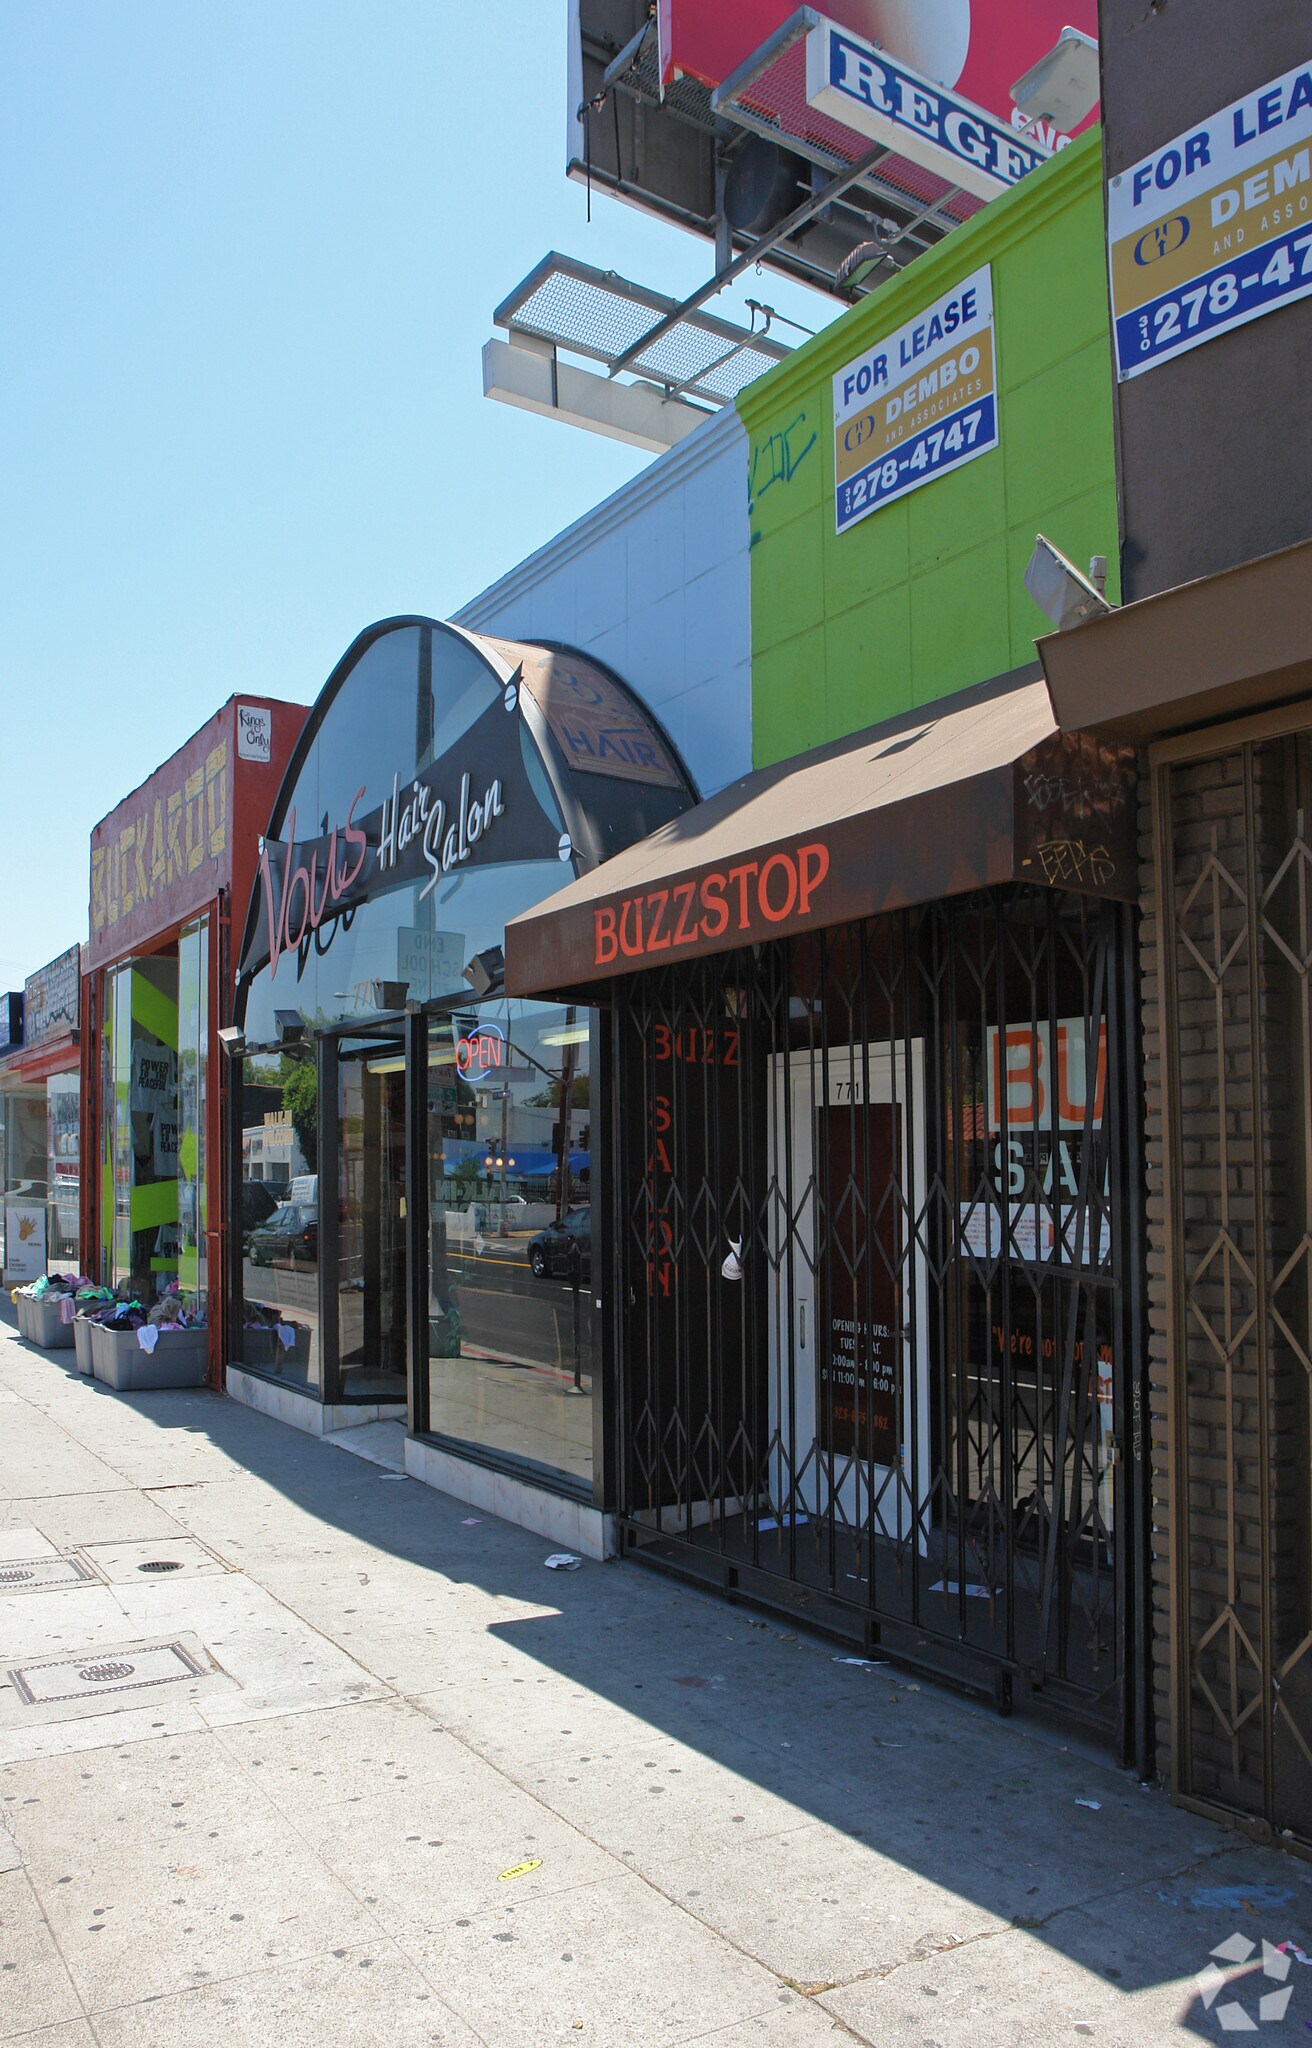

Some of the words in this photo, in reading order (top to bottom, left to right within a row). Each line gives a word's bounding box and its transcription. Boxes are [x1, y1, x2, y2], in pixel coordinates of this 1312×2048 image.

[1133, 130, 1211, 207] FOR
[1213, 228, 1244, 256] AND
[1260, 196, 1309, 232] ASSO
[843, 353, 889, 406] FOR
[900, 286, 978, 368] LEASE
[1138, 314, 1150, 352] 310
[885, 426, 904, 445] AND
[910, 378, 982, 429] ASSOCIATES
[886, 346, 981, 425] DEMBO
[852, 409, 982, 510] 278-4747
[246, 731, 269, 753] Only
[561, 725, 668, 773] HAIR
[377, 772, 431, 872] Hair
[420, 772, 505, 901] Salon
[594, 843, 829, 965] BUZZSTOP
[138, 1076, 166, 1091] PEACEFUL
[140, 1057, 169, 1073] POWER
[141, 1069, 149, 1078] TO
[456, 1036, 501, 1070] OPEN
